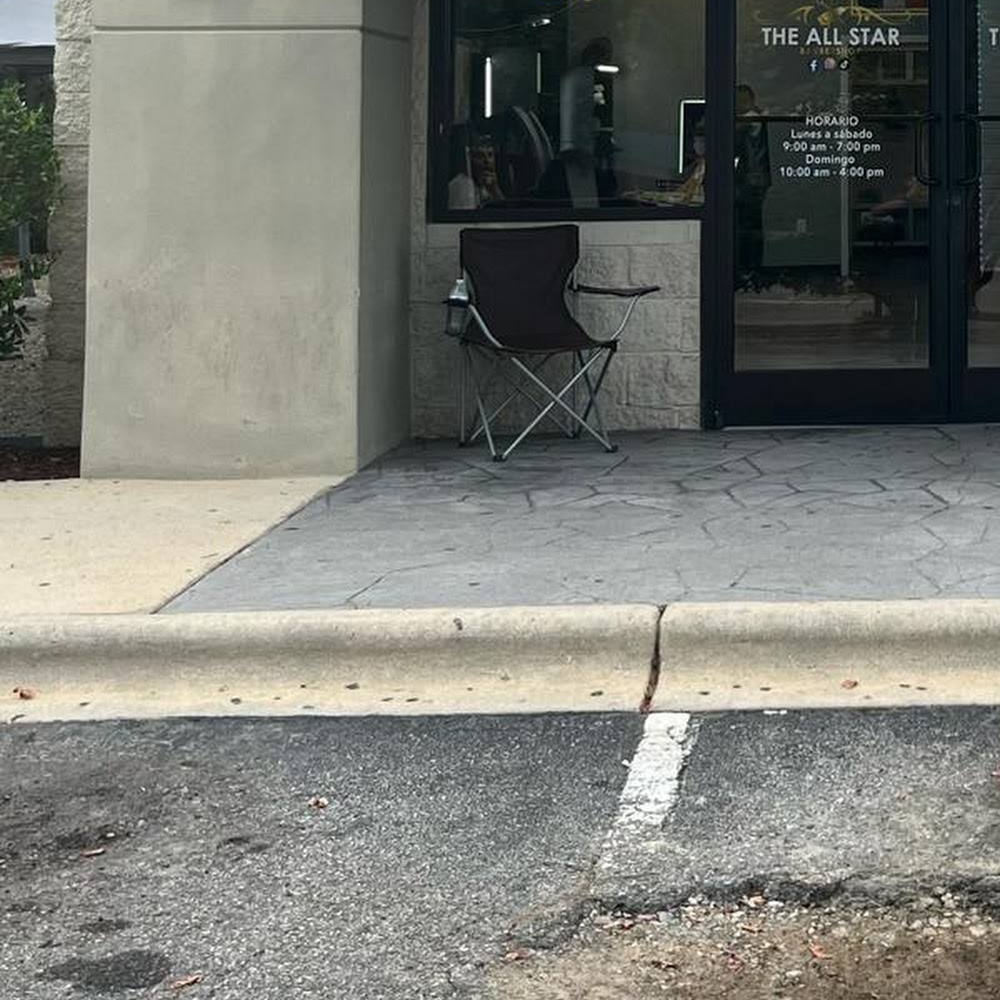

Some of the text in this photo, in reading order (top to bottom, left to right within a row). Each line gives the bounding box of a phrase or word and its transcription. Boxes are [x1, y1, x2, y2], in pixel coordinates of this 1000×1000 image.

[761, 27, 900, 46] THE ALL STAR
[805, 115, 859, 127] HORARIO
[790, 128, 822, 139] Lunes
[824, 131, 831, 139] a
[782, 141, 808, 152] 9:00
[810, 143, 827, 151] am
[836, 141, 861, 152] 7:00
[863, 143, 881, 154] pm
[805, 154, 855, 167] Domingo
[780, 166, 811, 177] 10:00
[813, 169, 830, 177] am
[839, 166, 864, 177] 4:00
[866, 169, 884, 179] pm
